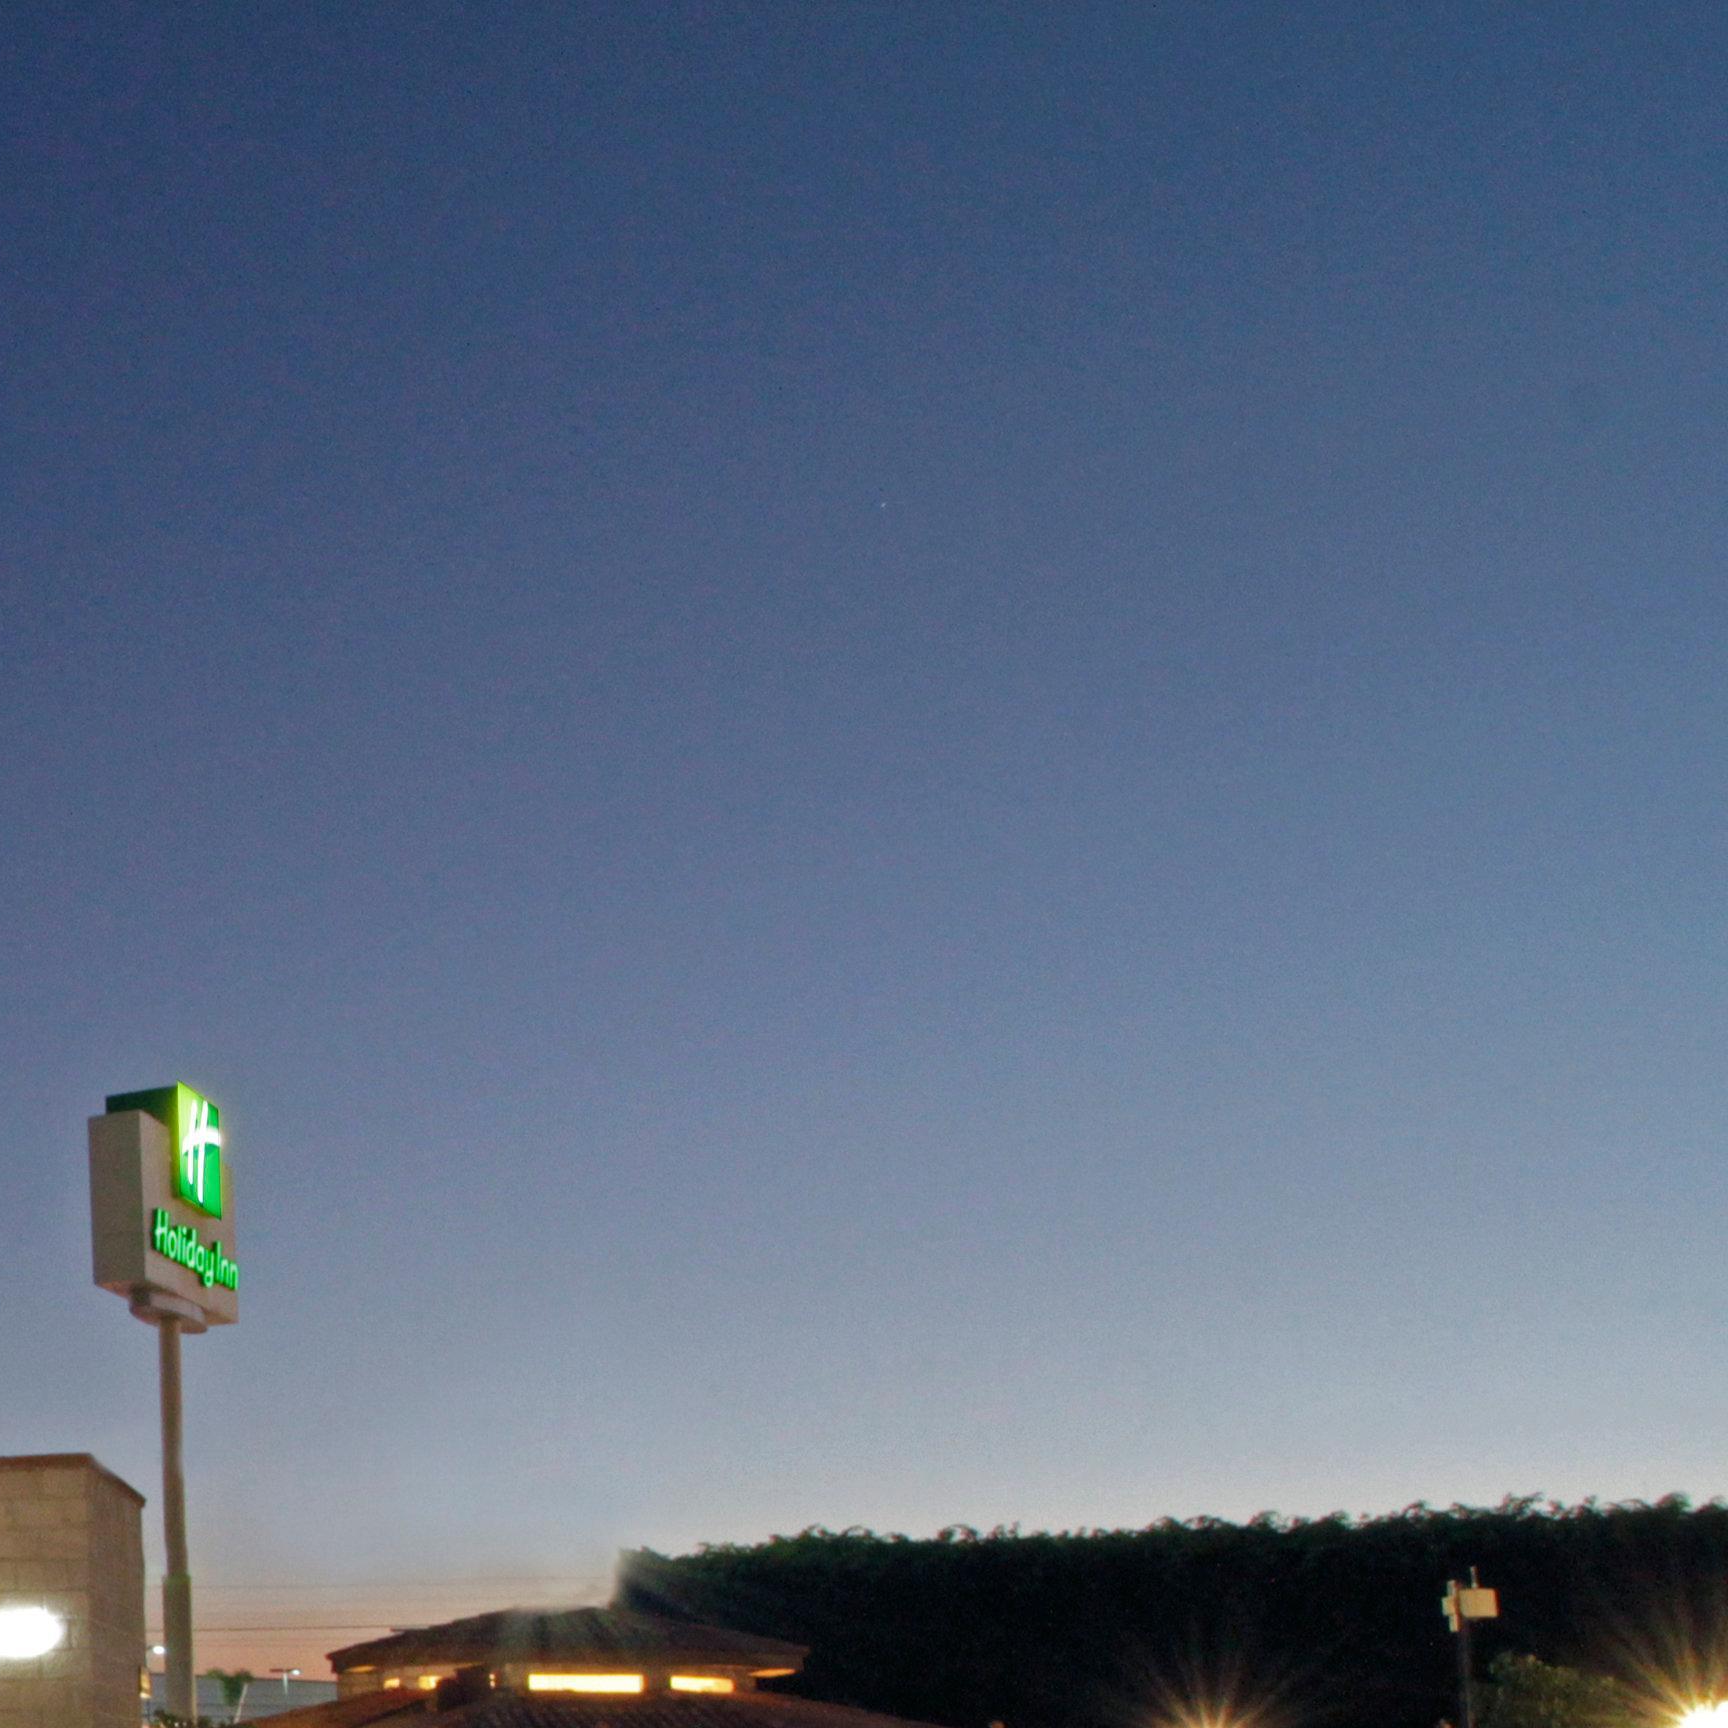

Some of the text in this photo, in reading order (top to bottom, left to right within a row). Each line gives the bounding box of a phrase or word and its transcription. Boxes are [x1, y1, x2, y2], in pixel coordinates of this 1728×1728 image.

[182, 1098, 222, 1204] H
[152, 1207, 239, 1290] Holiday Inn
